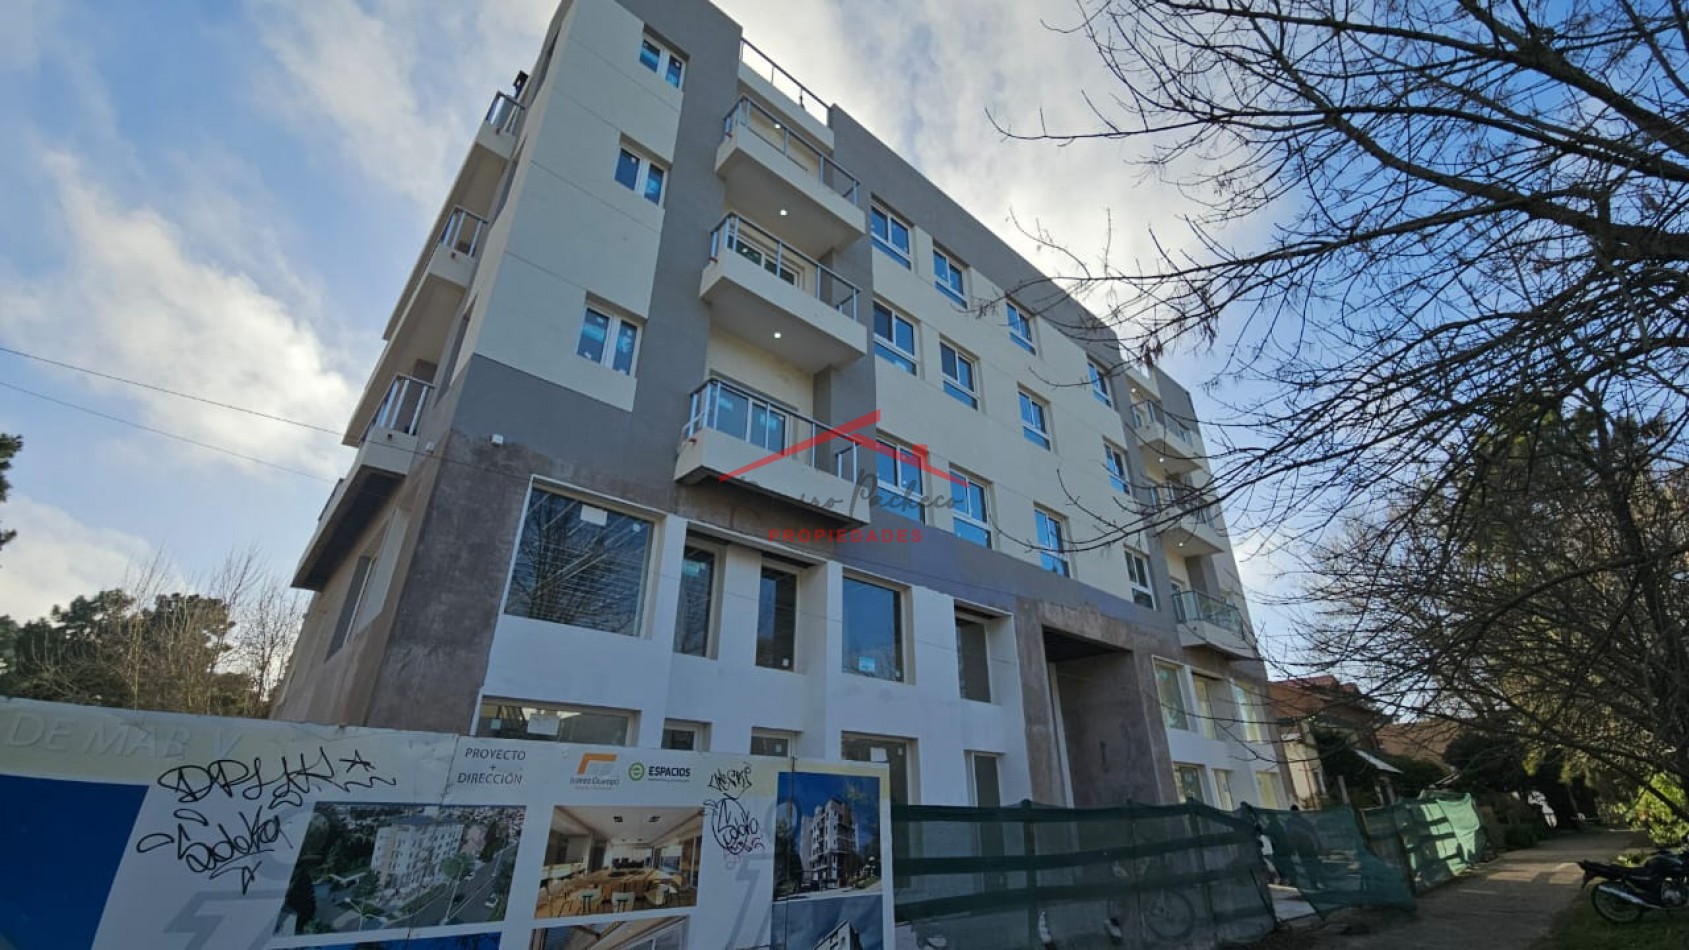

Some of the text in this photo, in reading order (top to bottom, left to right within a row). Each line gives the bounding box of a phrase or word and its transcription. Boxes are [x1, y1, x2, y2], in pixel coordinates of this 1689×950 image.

[465, 747, 526, 761] PROYECTO
[648, 766, 691, 777] ESPACIOS
[457, 772, 522, 785] DIRECCIÓN
